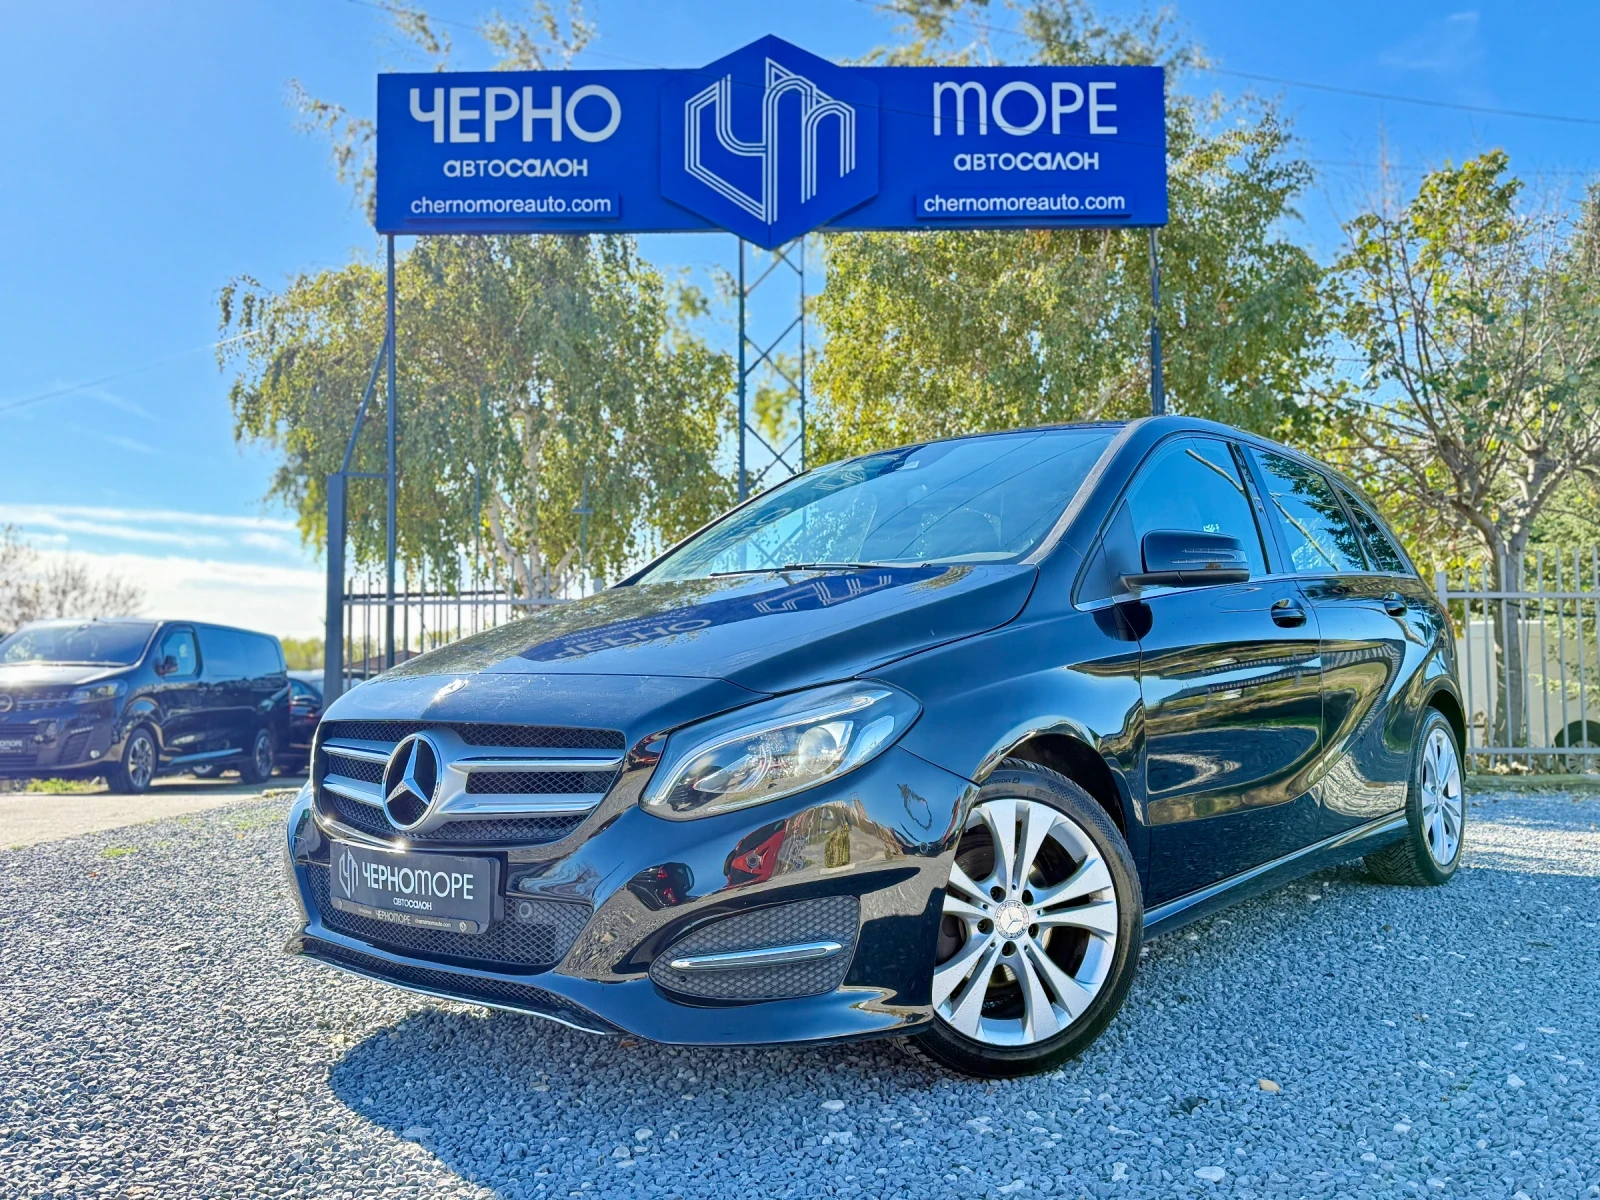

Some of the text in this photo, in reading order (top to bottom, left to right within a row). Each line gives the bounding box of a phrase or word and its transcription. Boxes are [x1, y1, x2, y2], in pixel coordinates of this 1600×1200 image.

[409, 84, 622, 143] ЧЕРНО
[410, 195, 612, 214] chernomoreauto.com
[923, 193, 1126, 212] chernomoreauto.com
